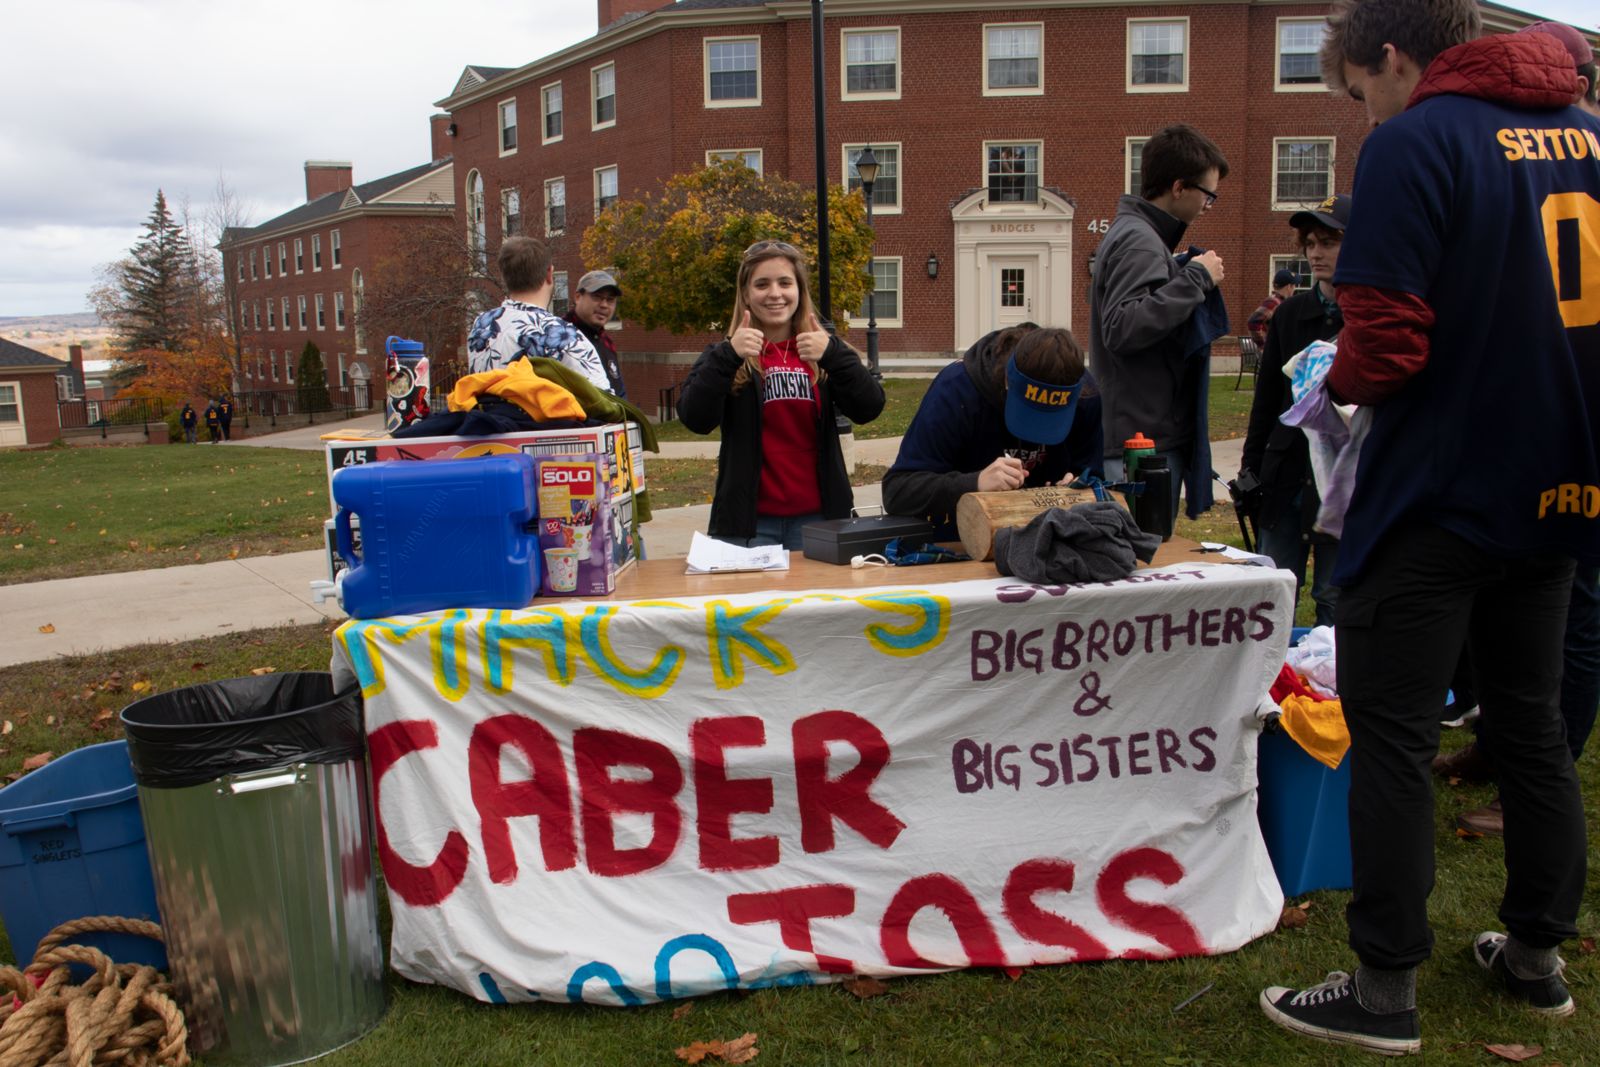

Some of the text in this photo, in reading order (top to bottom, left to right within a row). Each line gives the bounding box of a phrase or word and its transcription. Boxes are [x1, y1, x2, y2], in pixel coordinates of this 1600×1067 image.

[990, 223, 1036, 233] BRIDGES
[1087, 219, 1110, 234] 45
[764, 371, 815, 402] RUNSW
[1025, 383, 1072, 406] MACK
[543, 470, 591, 484] SOLO
[970, 601, 1276, 681] BIG BROTHERS
[1073, 671, 1113, 717] &
[952, 726, 1218, 794] BIG SISTERS
[366, 709, 907, 907] CABER
[40, 840, 65, 849] RED
[727, 847, 1210, 974] TOSS
